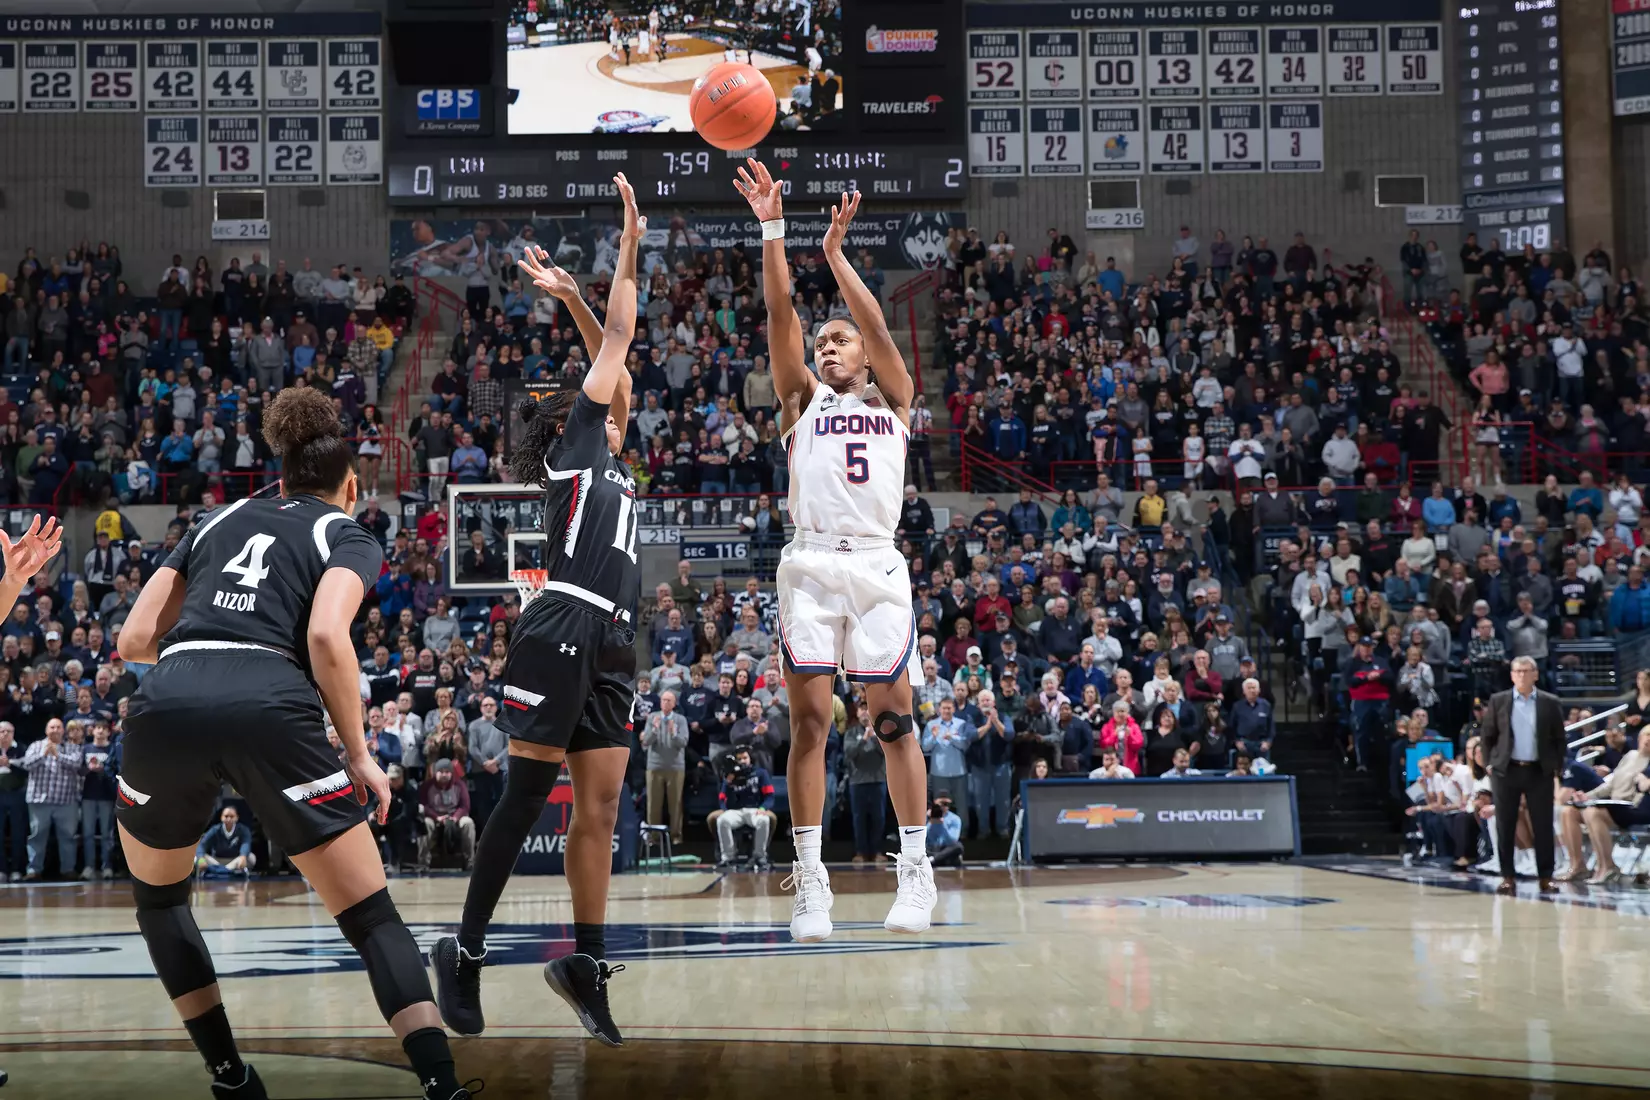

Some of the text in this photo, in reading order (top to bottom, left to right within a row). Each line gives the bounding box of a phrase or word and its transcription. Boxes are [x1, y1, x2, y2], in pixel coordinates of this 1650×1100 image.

[1071, 4, 1335, 20] UCONN HUSKIES OF HONOR
[7, 18, 275, 31] UCONN HUSKIES OF HONOR
[886, 41, 935, 50] DONUTS
[976, 61, 1014, 87] 52
[1095, 60, 1134, 85] 00
[1158, 58, 1191, 84] 13
[1215, 58, 1255, 83] 42
[1282, 57, 1305, 82] 34
[1343, 55, 1365, 81] 32
[1402, 54, 1427, 80] 50
[31, 72, 71, 98] 22
[91, 72, 132, 98] 25
[153, 71, 194, 97] 42
[213, 70, 254, 96] 44
[334, 69, 375, 95] 42
[417, 89, 474, 109] CBS
[862, 102, 930, 114] TRAVELERS
[597, 150, 628, 160] BONUS
[774, 148, 798, 158] POSS
[986, 136, 1006, 162] 15
[1045, 135, 1067, 161] 22
[1163, 134, 1187, 160] 42
[1224, 132, 1248, 159] 13
[1291, 132, 1300, 157] 3
[152, 146, 193, 172] 24
[217, 145, 249, 171] 13
[275, 145, 312, 171] 22
[556, 151, 580, 161] POSS
[663, 152, 710, 175] 7:59
[414, 166, 431, 195] 0
[945, 158, 963, 187] 2
[454, 188, 480, 199] FULL
[498, 184, 548, 199] 3 30 SEC
[567, 183, 618, 198] 0 TM FLS
[782, 180, 792, 196] 0
[807, 179, 857, 194] 30 SEC 3
[874, 180, 900, 192] FULL
[1088, 212, 1142, 226] SEC 216
[1408, 208, 1463, 221] SEC 217
[1477, 207, 1550, 226] TIME OF DAY
[213, 224, 268, 237] SEC 214
[695, 223, 727, 234] Harry
[729, 222, 741, 232] A.
[885, 220, 901, 230] CT
[1499, 225, 1549, 250] 7:08
[851, 235, 887, 246] World
[815, 414, 895, 436] UCONN
[845, 442, 870, 485] 5
[650, 529, 679, 544] 215
[1265, 538, 1280, 549] SE
[222, 533, 276, 589] 4
[684, 543, 748, 560] SEC 116
[213, 590, 257, 612] RIZOR
[1157, 809, 1265, 822] CHEVROLET
